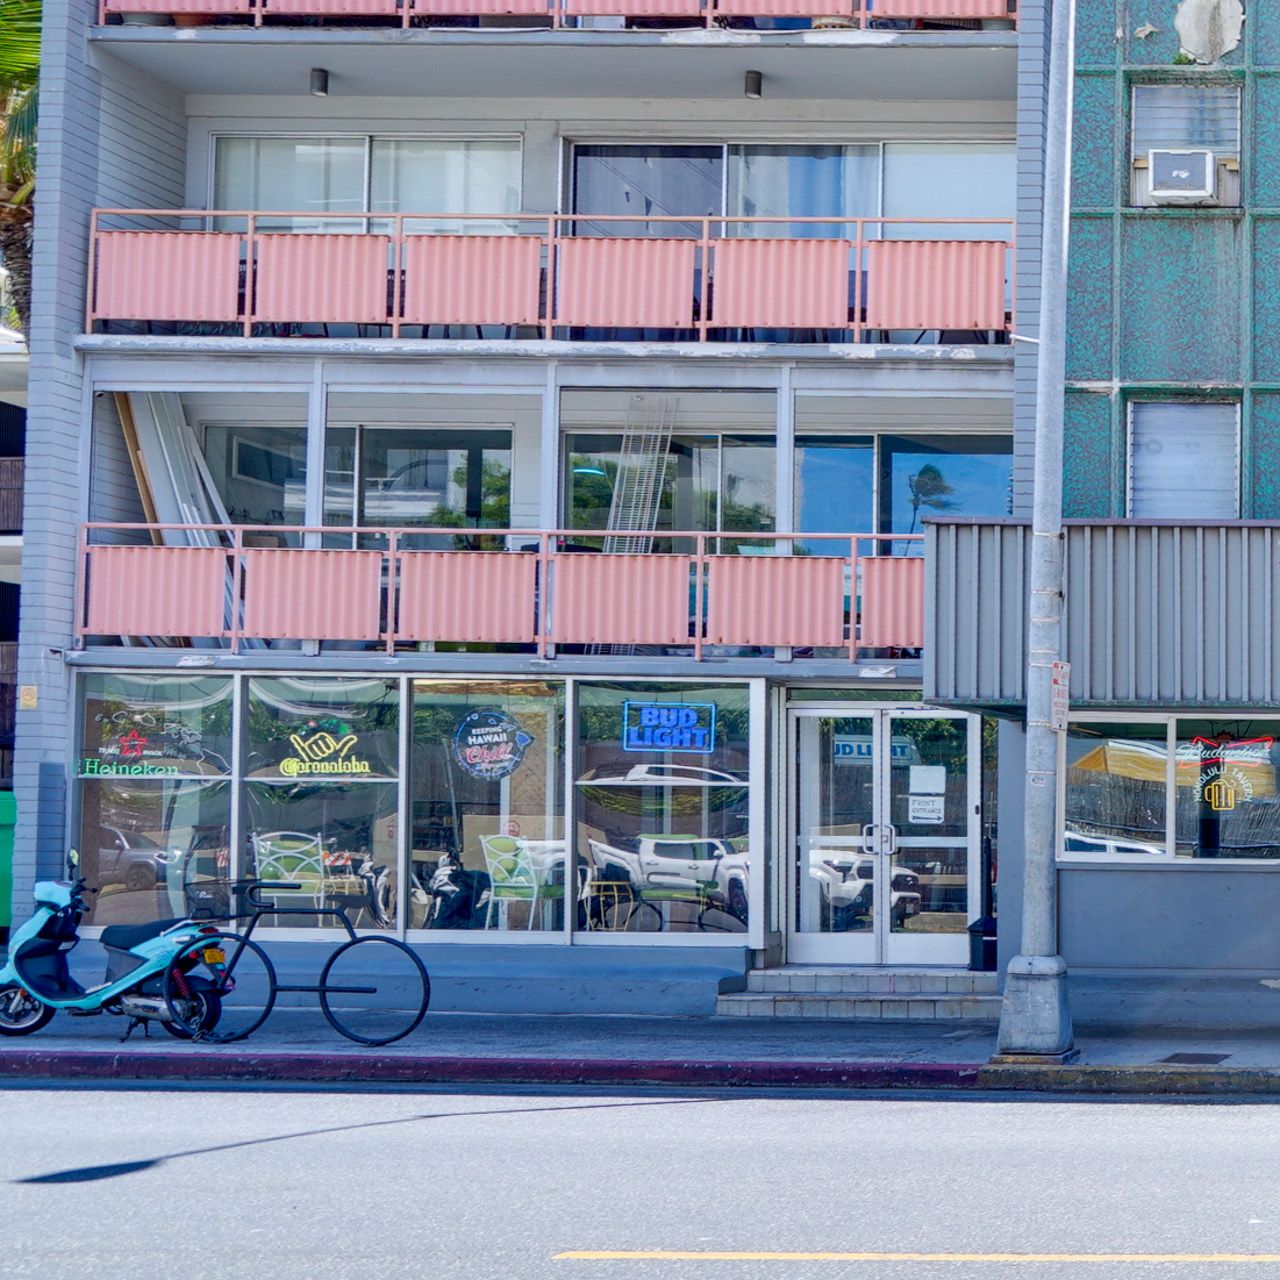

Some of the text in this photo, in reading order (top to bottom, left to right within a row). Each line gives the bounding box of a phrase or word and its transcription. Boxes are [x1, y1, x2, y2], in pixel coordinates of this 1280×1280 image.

[641, 708, 698, 728] BUD
[468, 733, 507, 745] HAWAII
[629, 727, 708, 748] LIGHT
[84, 758, 178, 776] Heineken
[1193, 765, 1254, 802] HONOLULU TAVERN
